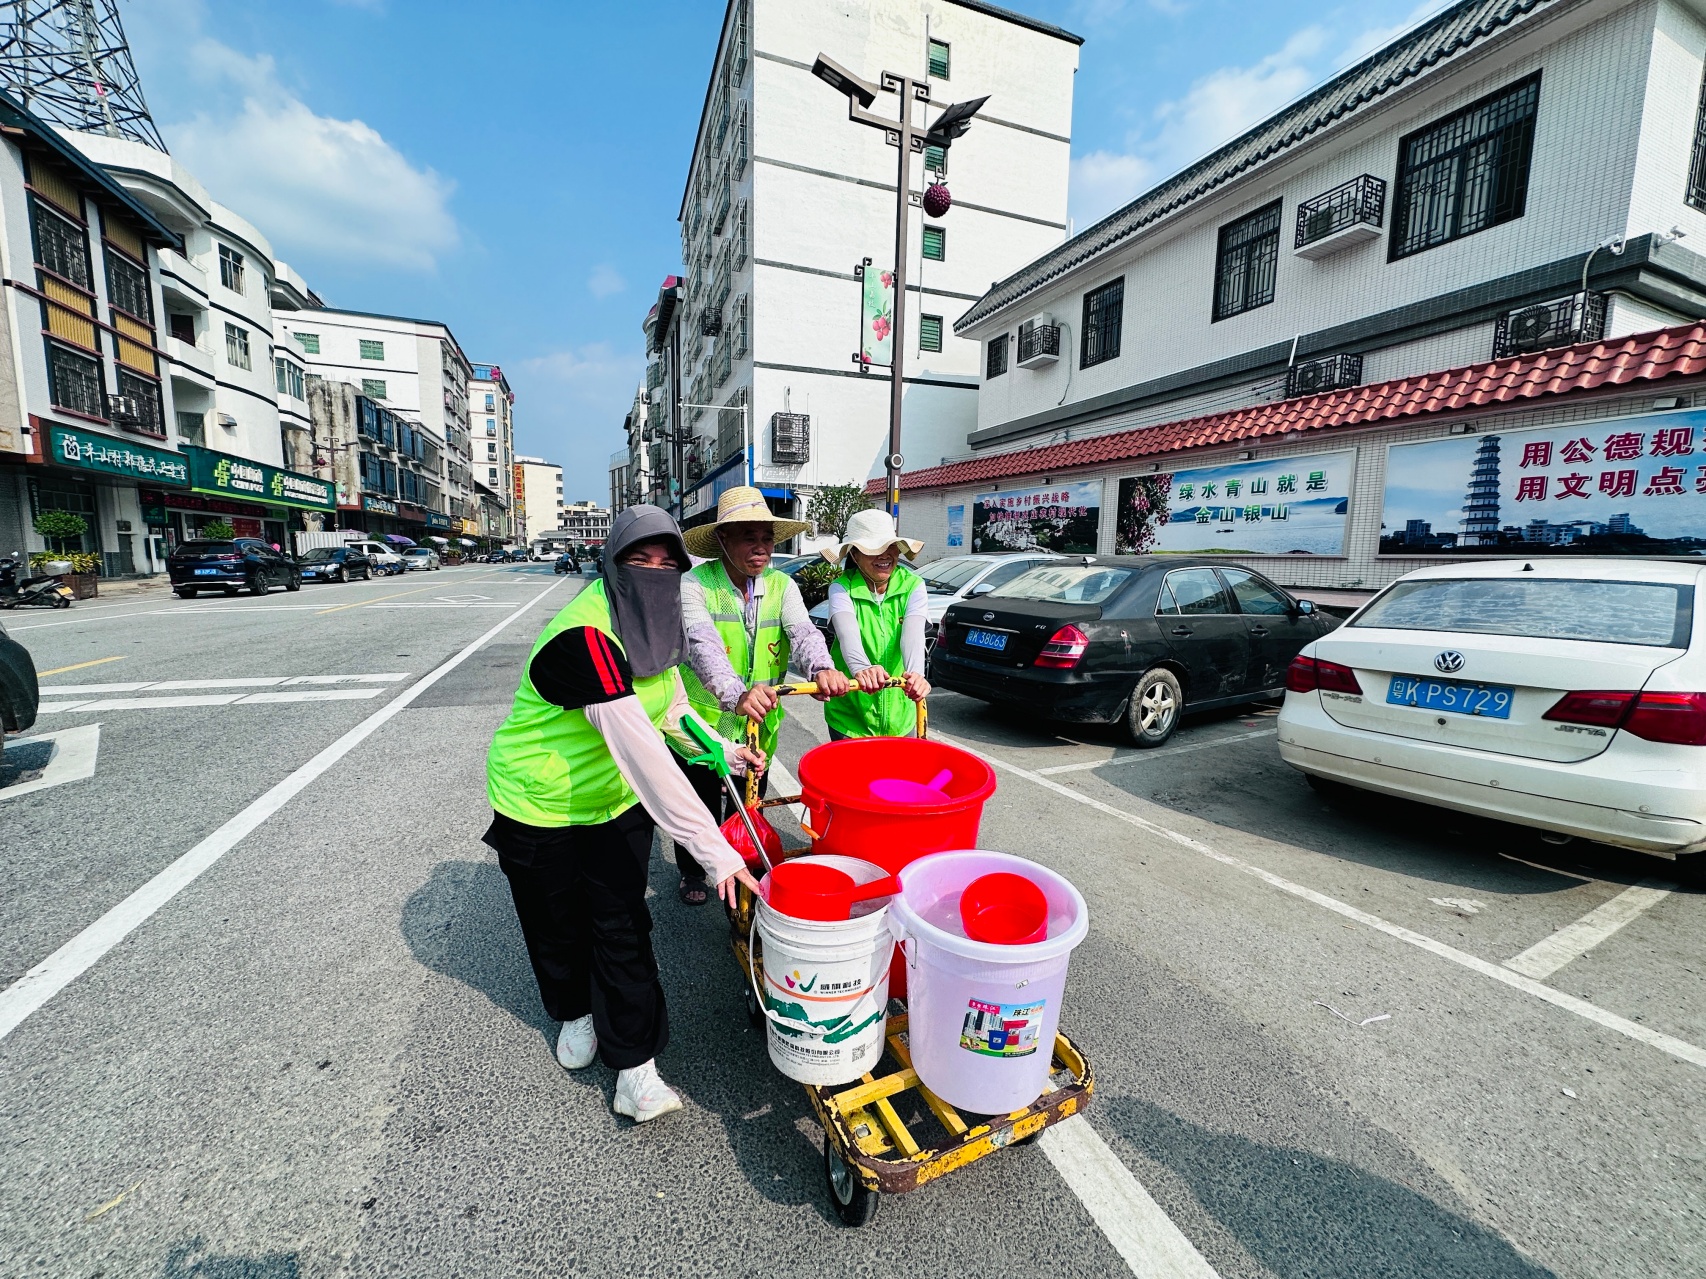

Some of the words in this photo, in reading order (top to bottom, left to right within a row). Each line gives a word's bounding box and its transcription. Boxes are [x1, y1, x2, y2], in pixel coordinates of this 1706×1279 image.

[1519, 427, 1706, 468] 用公德规
[1179, 470, 1327, 501] 绿水青山就是
[983, 491, 1070, 509] 深入实施乡村振兴战略
[1196, 503, 1289, 525] 金山银山
[1554, 724, 1607, 738] JETTA
